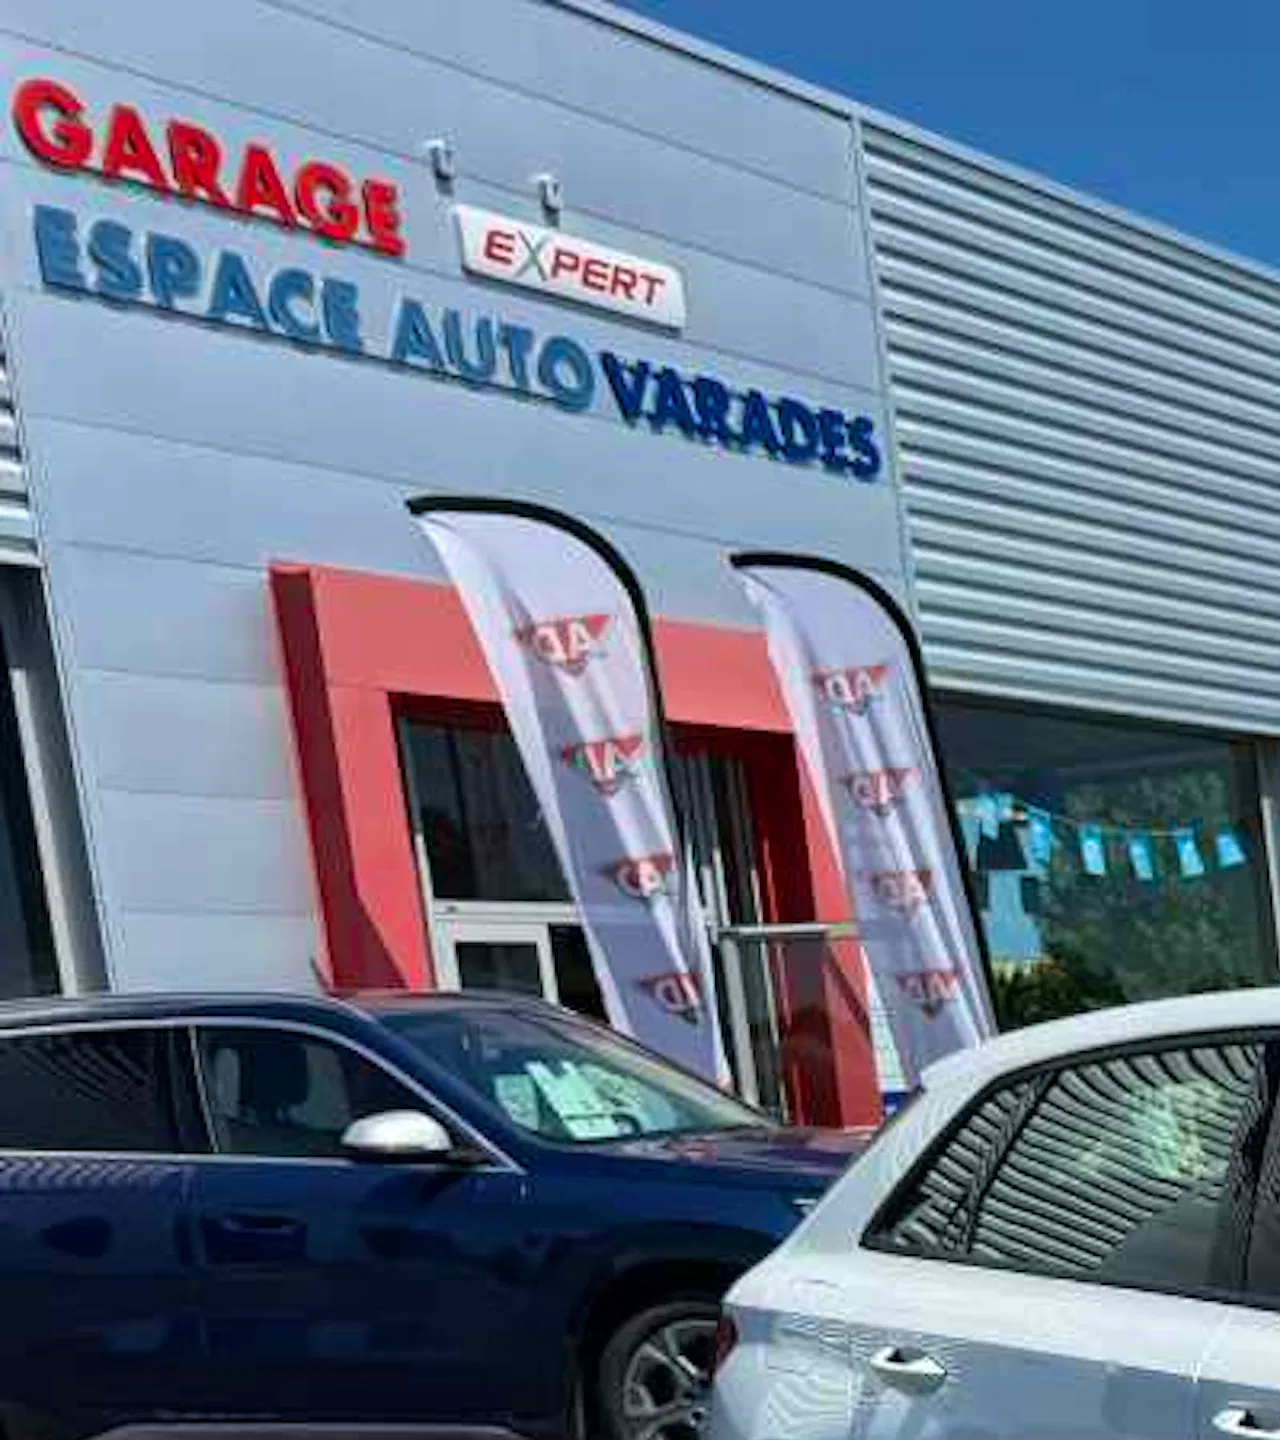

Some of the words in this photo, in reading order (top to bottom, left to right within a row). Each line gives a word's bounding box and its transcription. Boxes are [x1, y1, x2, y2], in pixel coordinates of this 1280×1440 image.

[13, 79, 407, 260] GARAGE
[33, 203, 365, 355] ESPACE
[391, 297, 596, 411] AUTO
[600, 350, 884, 482] VARADES
[483, 232, 666, 307] EXPERT
